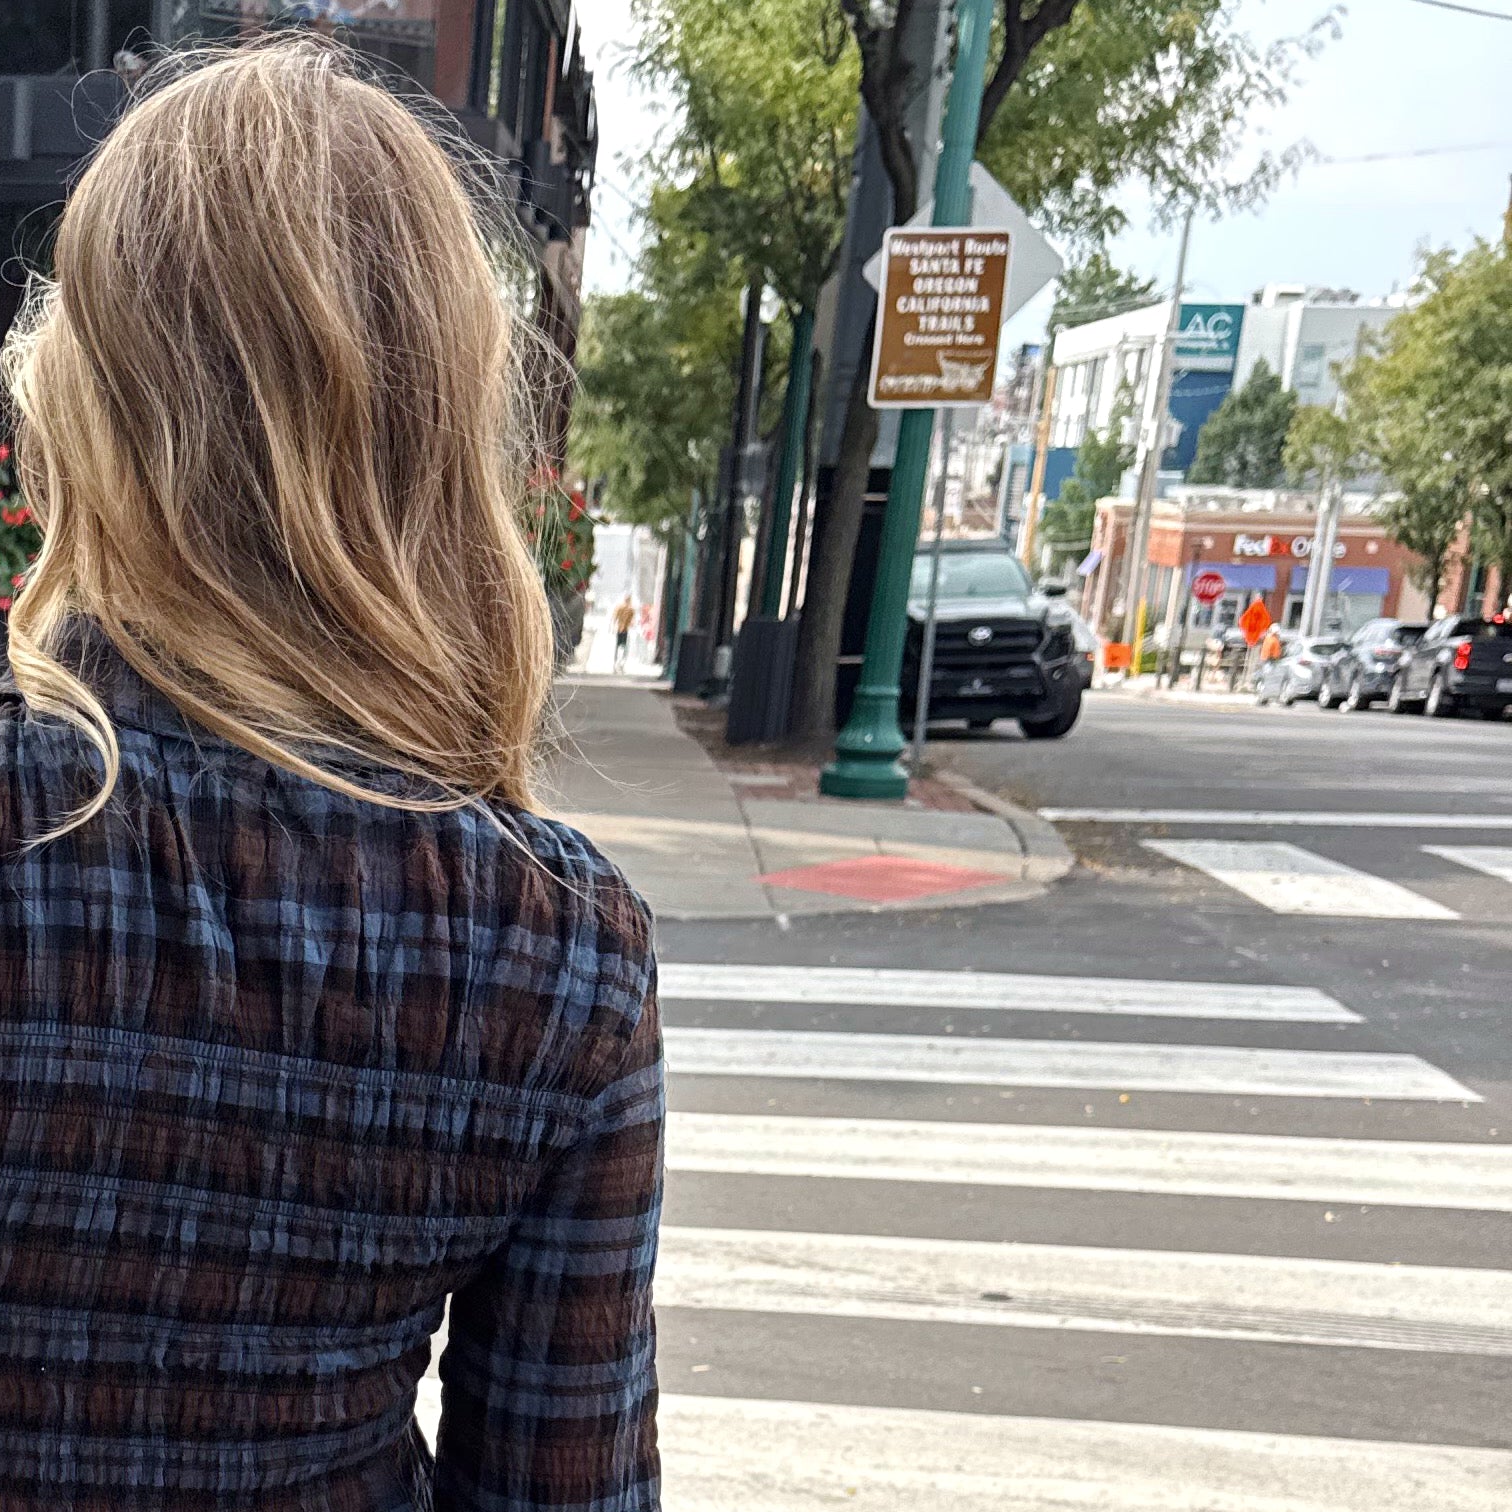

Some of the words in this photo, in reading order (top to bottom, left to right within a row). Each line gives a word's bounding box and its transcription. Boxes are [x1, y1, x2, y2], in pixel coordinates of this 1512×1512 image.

[909, 257, 961, 275] SANTA
[964, 257, 985, 275] FE
[913, 276, 979, 294] OREGON
[896, 295, 991, 314] CALIFORNIA
[918, 315, 975, 333] TRAILS
[1183, 312, 1234, 339] AC
[1233, 533, 1289, 557] FedEx
[1192, 578, 1225, 594] STOP
